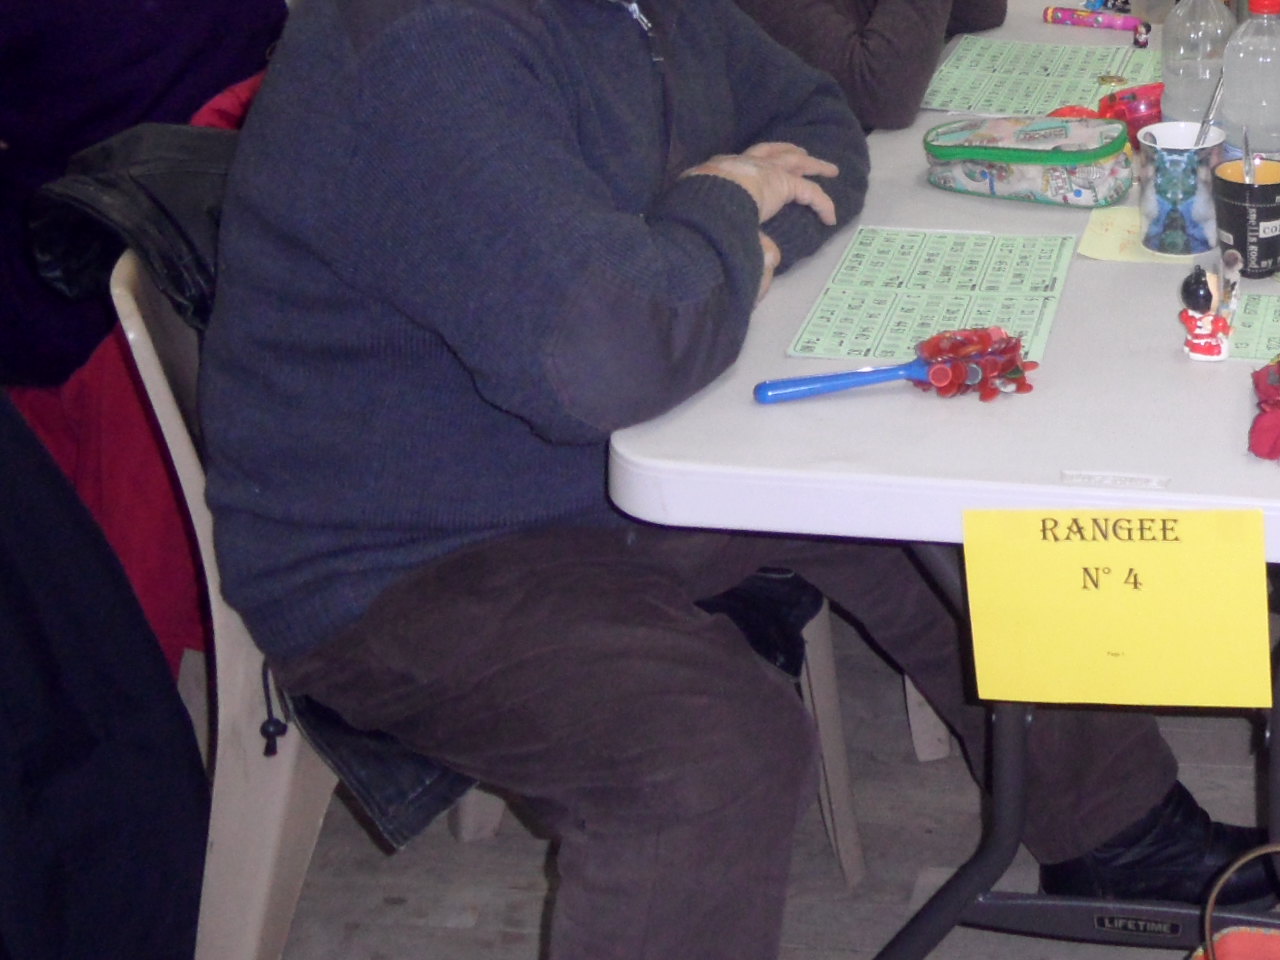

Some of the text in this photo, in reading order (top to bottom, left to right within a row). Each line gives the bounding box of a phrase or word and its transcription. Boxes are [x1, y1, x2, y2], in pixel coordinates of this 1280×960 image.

[1040, 518, 1180, 542] RANGEE
[1081, 567, 1143, 590] N° 4
[1104, 918, 1171, 934] LIFETIME
